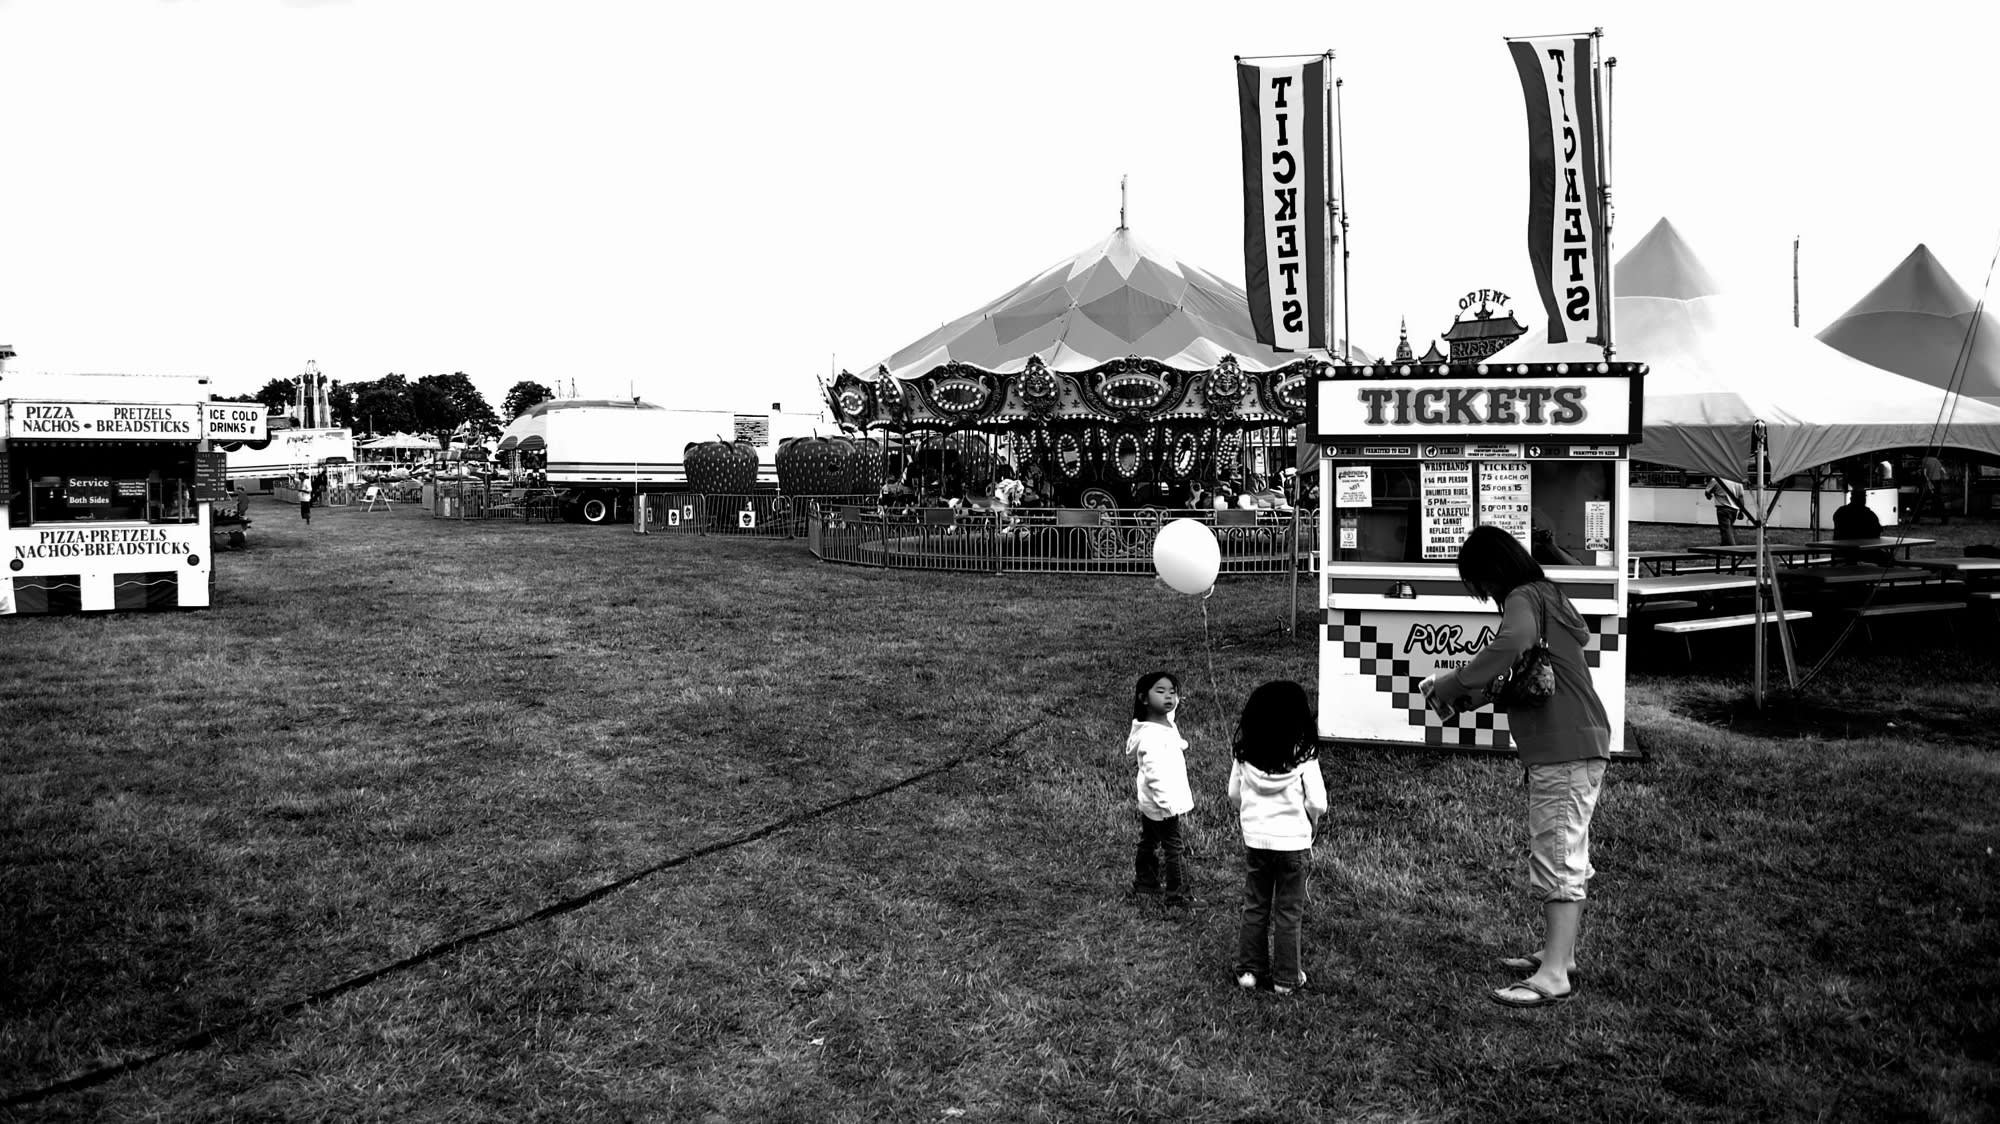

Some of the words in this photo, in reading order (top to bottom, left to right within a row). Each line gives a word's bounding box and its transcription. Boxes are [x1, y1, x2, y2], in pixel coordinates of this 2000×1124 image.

[1458, 288, 1511, 310] ORIENT
[1358, 386, 1588, 426] TICKETS
[26, 406, 75, 419] PIZZA
[114, 407, 172, 420] PRETZELS
[209, 409, 225, 420] ICE
[232, 410, 258, 422] COLD
[23, 419, 80, 432] NACHOS
[96, 419, 190, 433] BREADSTICKS
[209, 422, 247, 433] DRINKS
[1424, 461, 1469, 472] WRISTBANDS
[1483, 463, 1528, 471] TICKETS
[69, 477, 110, 487] Service
[1481, 473, 1493, 481] 75
[1481, 483, 1491, 491] 25
[69, 496, 88, 504] Both
[89, 496, 110, 504] Sides
[1425, 507, 1435, 517] BE
[1437, 507, 1470, 517] CAREFUL!
[1516, 504, 1529, 512] 30
[1429, 527, 1451, 535] REPLACE
[1403, 623, 1465, 656] POOR
